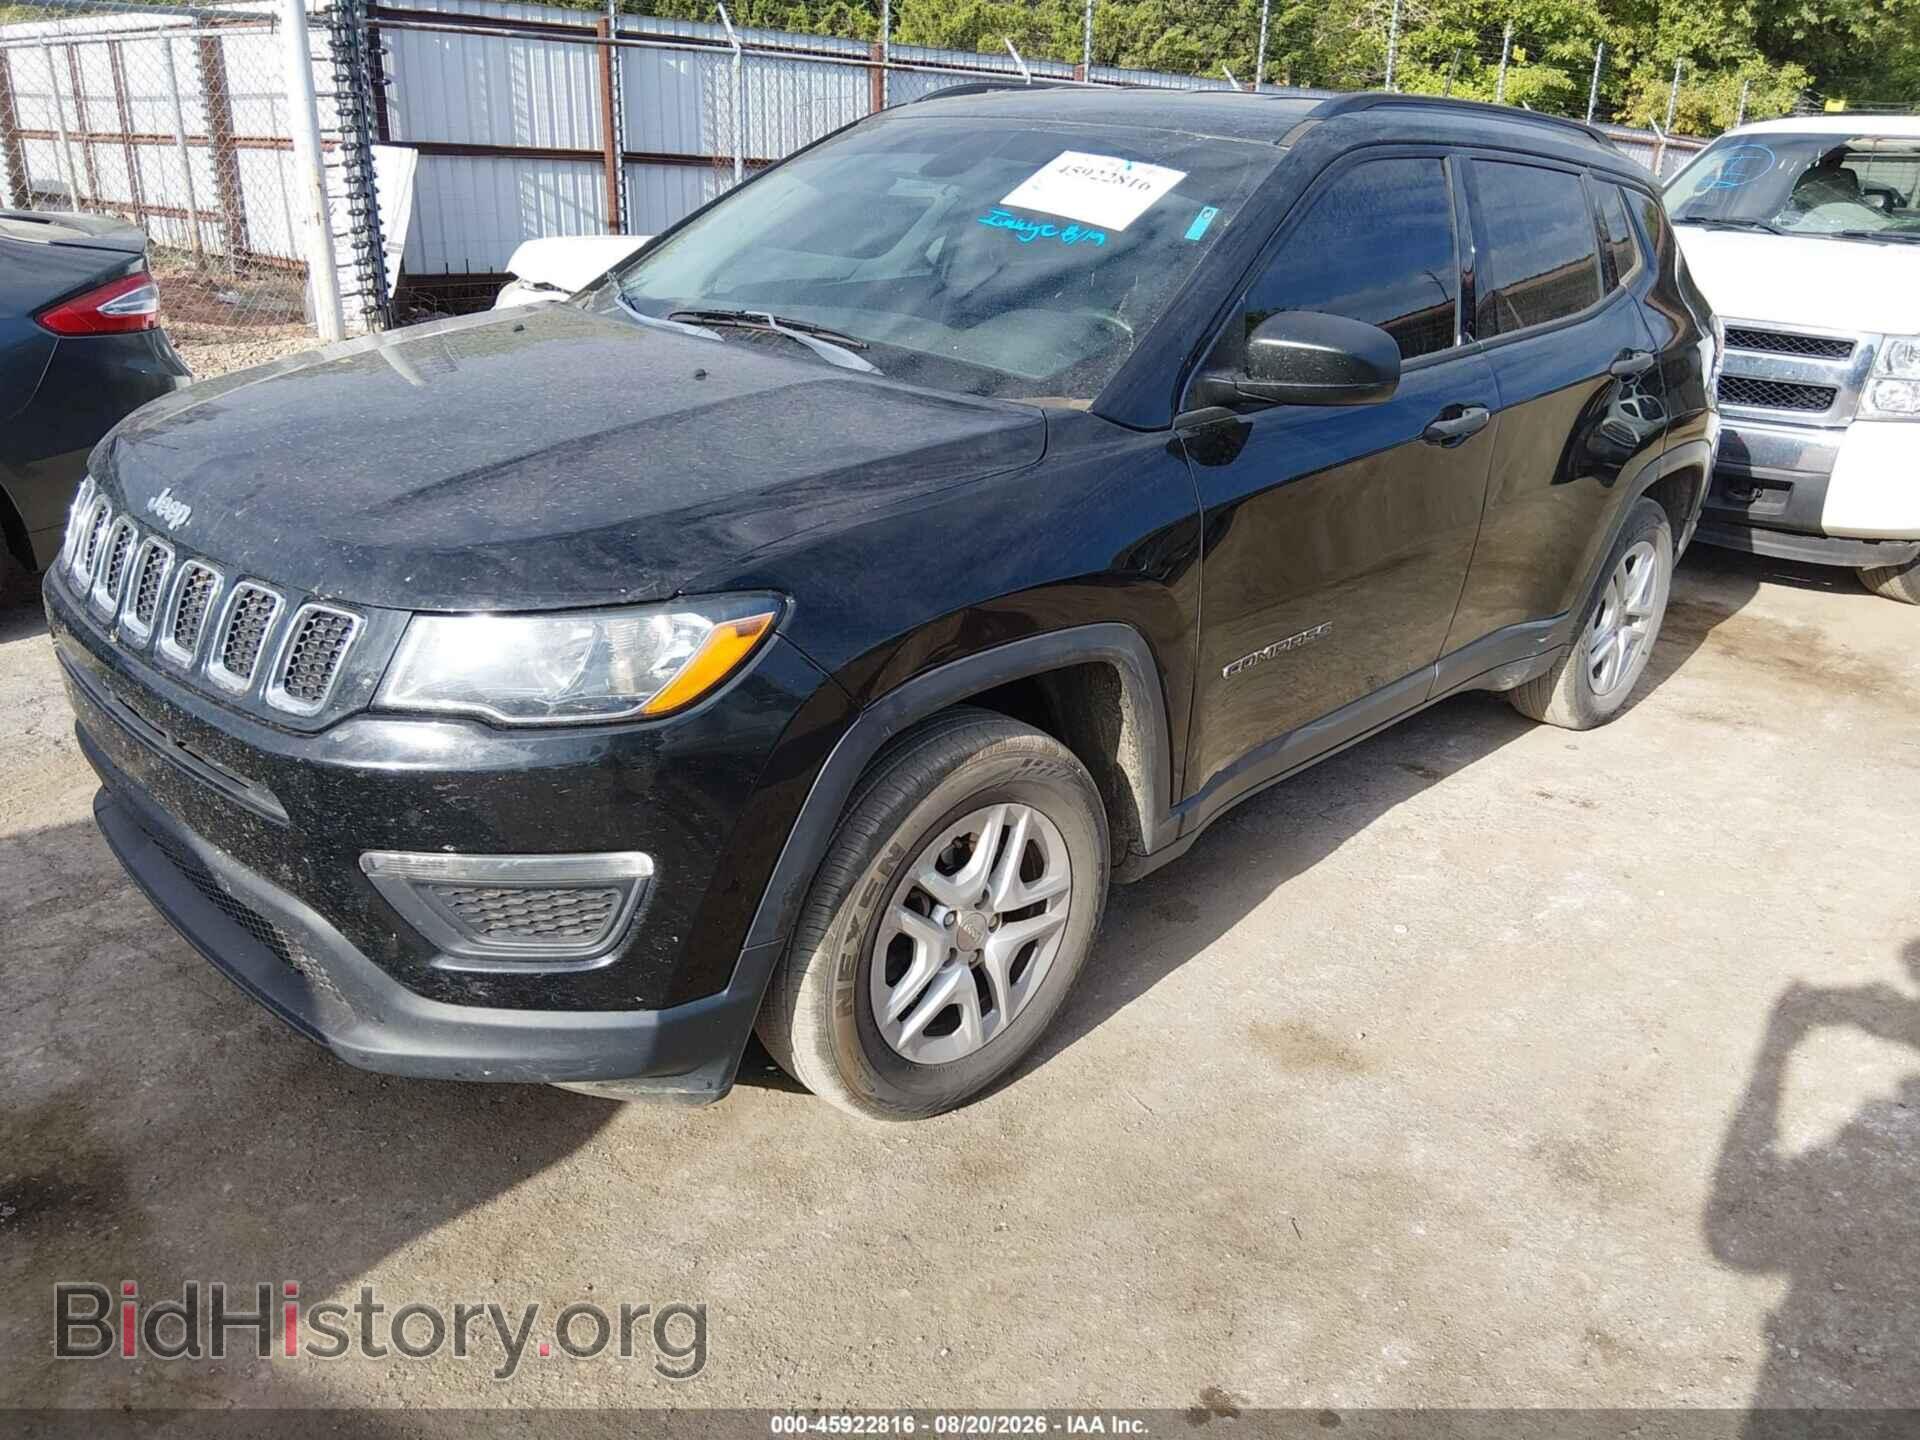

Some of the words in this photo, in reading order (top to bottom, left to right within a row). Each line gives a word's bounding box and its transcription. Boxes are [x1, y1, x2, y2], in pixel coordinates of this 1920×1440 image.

[146, 487, 192, 531] Jeep
[1222, 620, 1334, 679] COMPASS
[835, 840, 907, 1018] NEXEN
